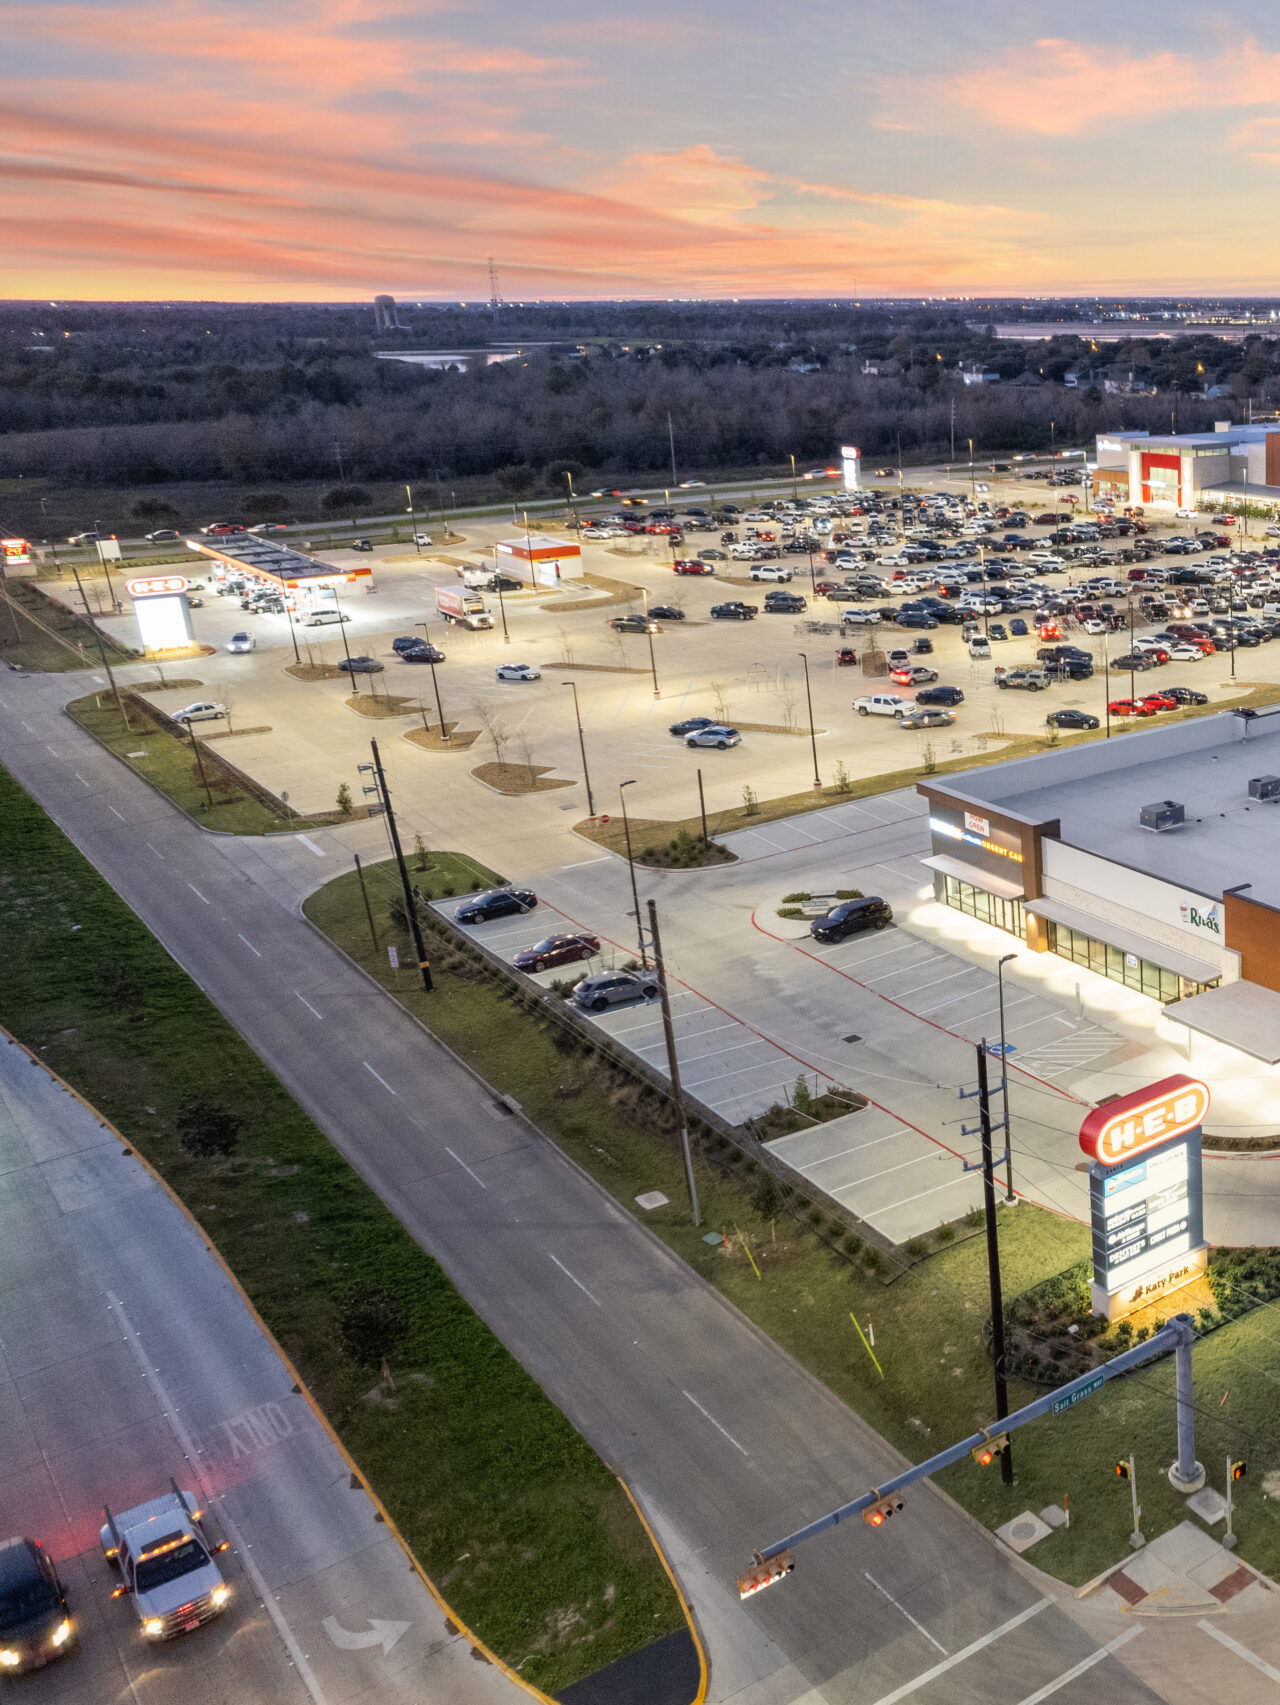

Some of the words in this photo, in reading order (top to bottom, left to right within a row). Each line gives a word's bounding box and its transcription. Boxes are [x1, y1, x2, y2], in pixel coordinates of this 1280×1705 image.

[968, 820, 985, 832] OPEN
[982, 840, 1008, 856] URGENT
[1008, 851, 1024, 863] CAR
[1145, 1278, 1166, 1295] Katy
[1168, 1266, 1189, 1283] Park
[1054, 1399, 1069, 1413] Salt
[1072, 1387, 1092, 1402] Grass
[222, 1402, 293, 1459] ONLY
